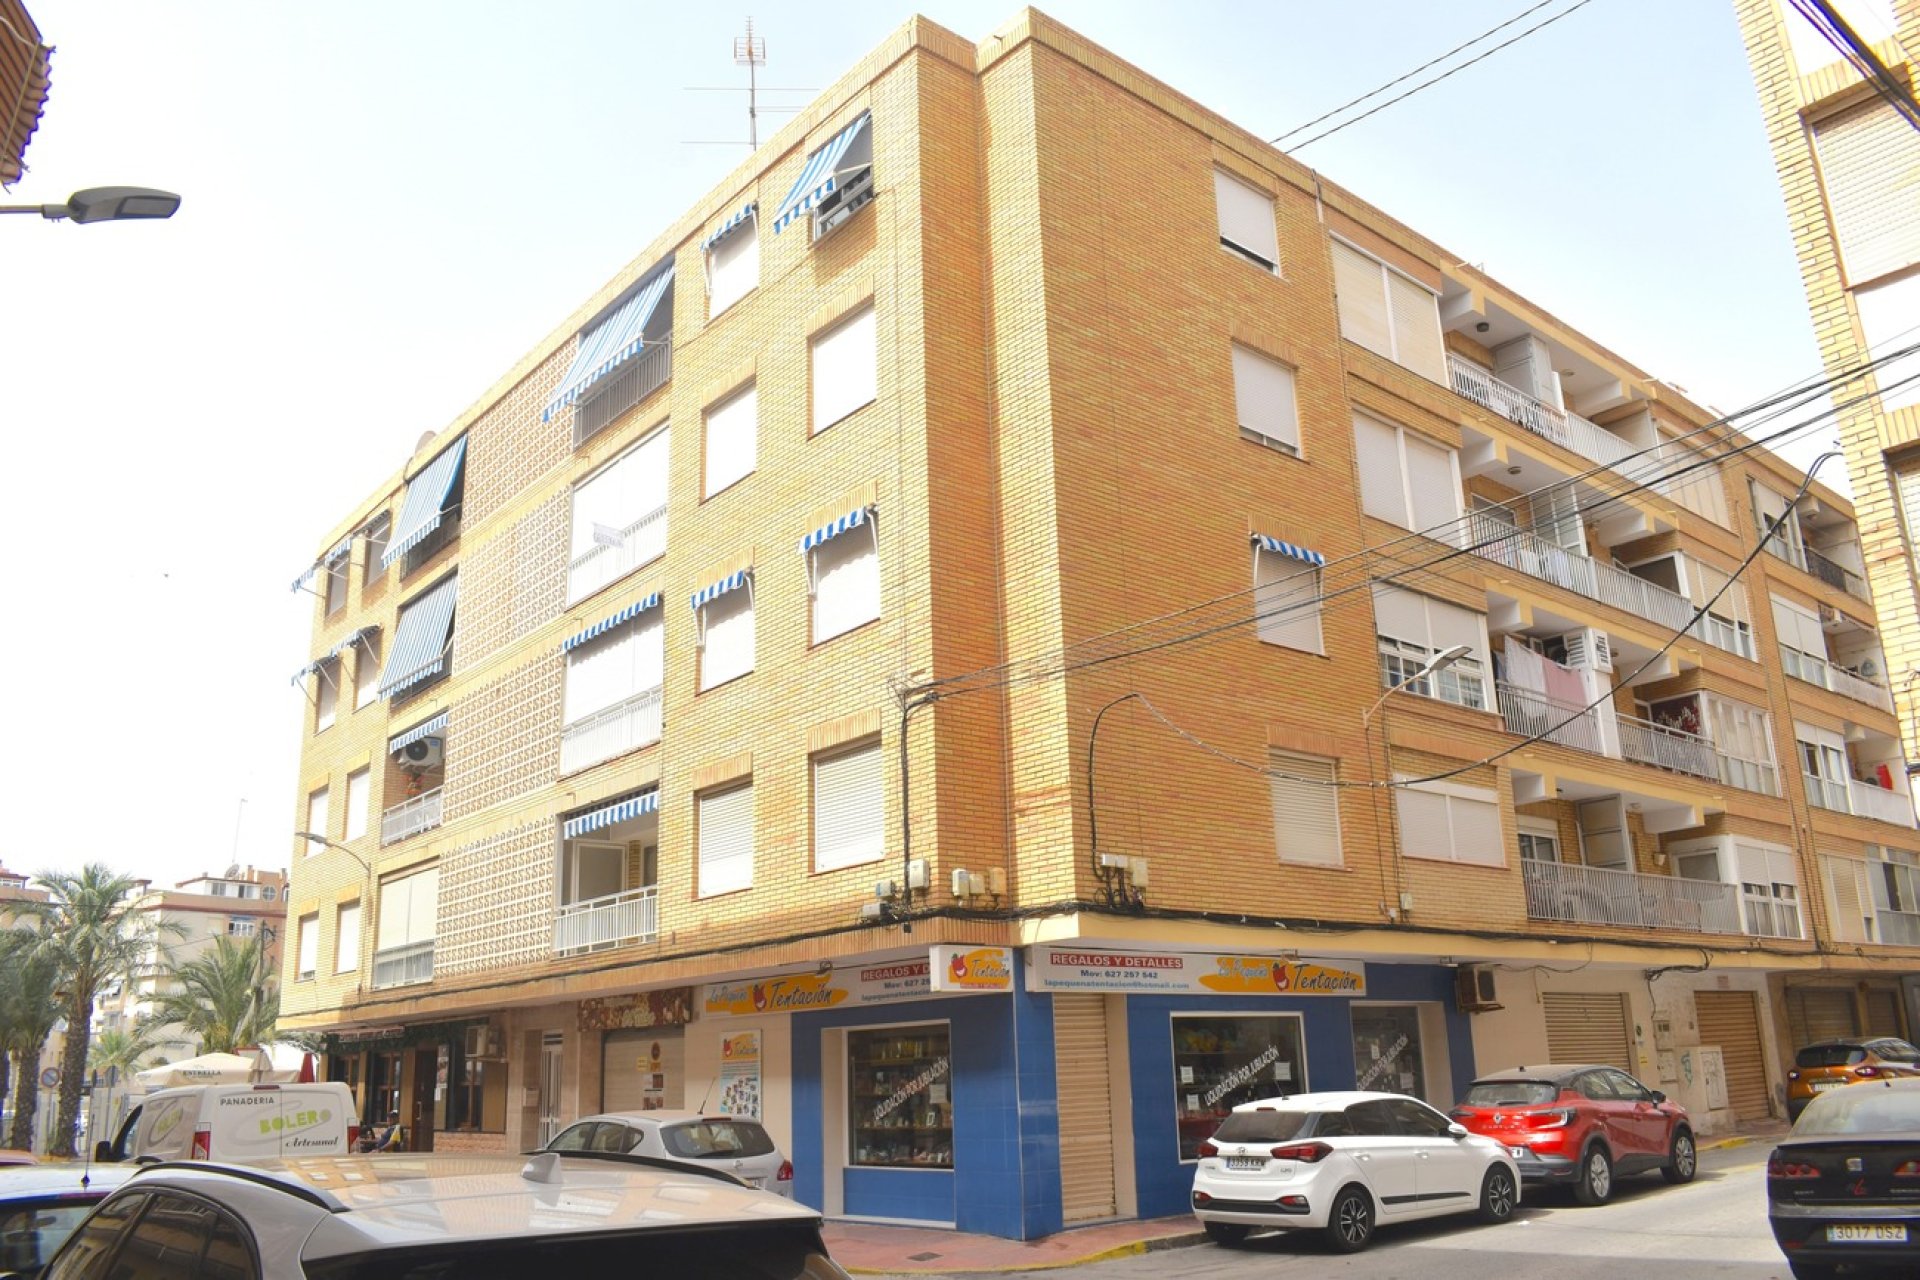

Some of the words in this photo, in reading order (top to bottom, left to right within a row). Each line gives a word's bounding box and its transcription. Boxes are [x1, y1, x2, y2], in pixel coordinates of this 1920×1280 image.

[1052, 954, 1110, 966] REGALOS
[1112, 956, 1121, 966] Y
[1125, 957, 1182, 968] DETALLES
[863, 966, 910, 981] REGALOS
[912, 963, 921, 976] Y
[1080, 969, 1103, 978] Mov:
[1105, 970, 1121, 978] 627
[1293, 963, 1357, 990] Tentación
[770, 981, 833, 1008] Tentación
[220, 1096, 274, 1106] PANADERIA
[1836, 1225, 1871, 1240] 3017
